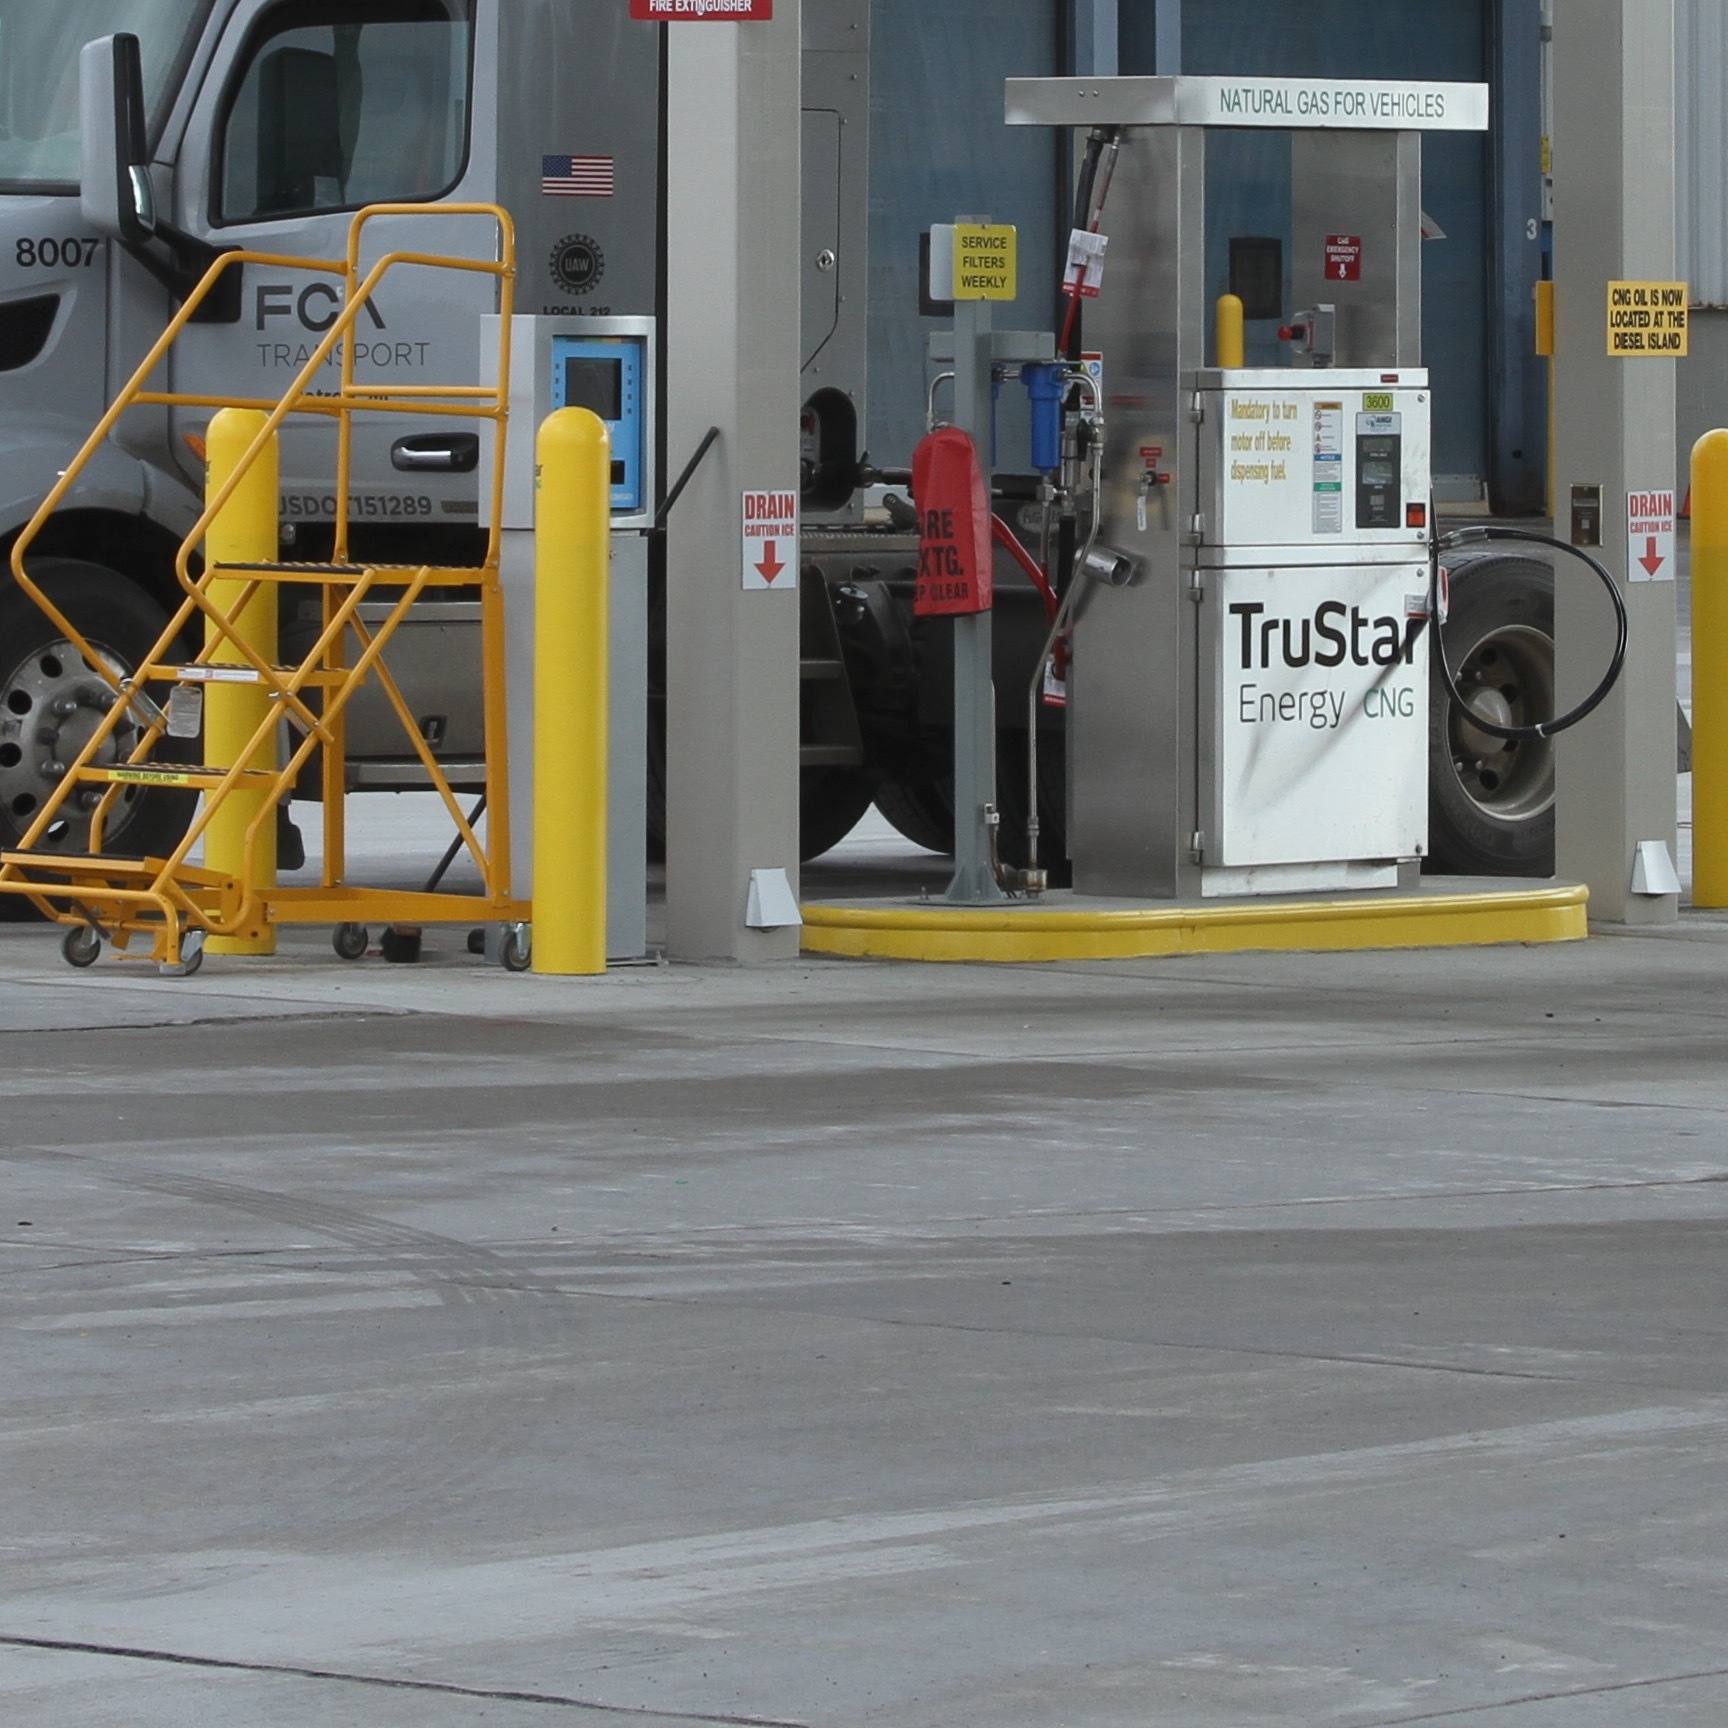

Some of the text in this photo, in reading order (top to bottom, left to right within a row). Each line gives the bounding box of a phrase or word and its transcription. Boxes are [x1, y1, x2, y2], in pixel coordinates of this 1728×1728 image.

[1220, 88, 1445, 118] NATURAL GAS FOR VEHICLES
[1526, 218, 1537, 240] 3
[16, 237, 99, 268] 8007
[961, 236, 1007, 250] SERVICE
[565, 258, 589, 272] UAW
[963, 256, 1005, 269] FILTERS
[961, 275, 1007, 289] WEEKLY
[1612, 288, 1683, 306] CNG OIL IS NOW
[543, 306, 610, 316] LOCAL 212
[1610, 310, 1685, 328] LOCATED AT THE
[1614, 332, 1681, 350] DIESEL ISLAND
[1231, 399, 1297, 424] Mandatory to turn
[1366, 395, 1390, 409] 3600
[1231, 430, 1291, 451] motor off before
[1231, 459, 1269, 485] dispensing
[745, 494, 794, 520] DRAIN
[1629, 493, 1672, 517] DRAIN
[745, 523, 795, 537] CAUTION ICE
[1630, 521, 1672, 533] CAUTION ICE
[919, 545, 964, 577] XTG.
[929, 582, 969, 601] CLEAR
[1229, 600, 1424, 669] TruStar
[1240, 683, 1414, 729] Energy CNG
